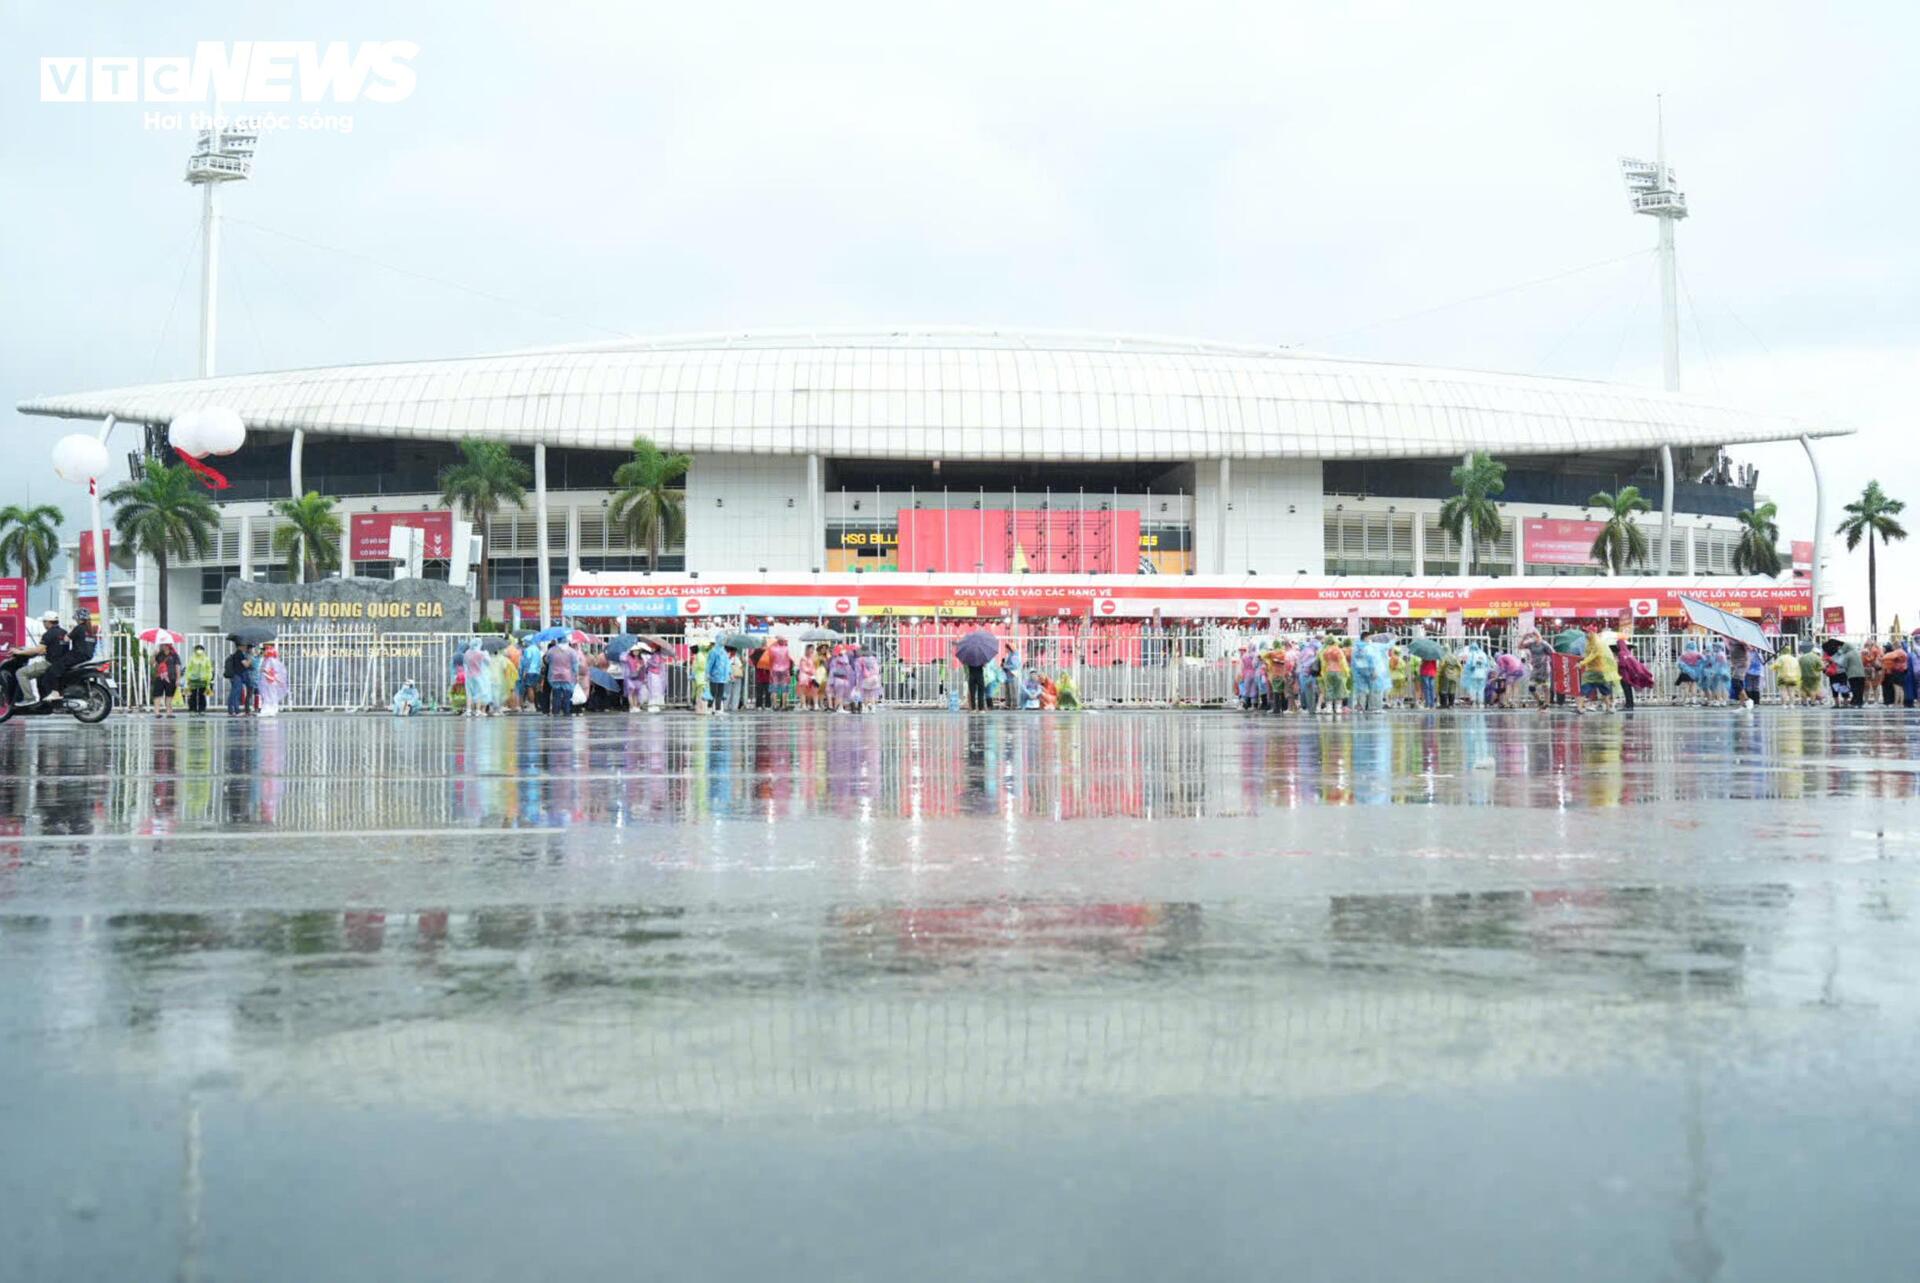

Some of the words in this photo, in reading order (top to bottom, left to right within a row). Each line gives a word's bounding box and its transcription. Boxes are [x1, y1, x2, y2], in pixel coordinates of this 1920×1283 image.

[841, 533, 866, 545] HSG
[563, 588, 586, 596] KHU
[1319, 590, 1339, 598] KHU
[242, 598, 276, 617] SÂN
[282, 598, 314, 620] VẬN
[416, 602, 442, 617] GIA
